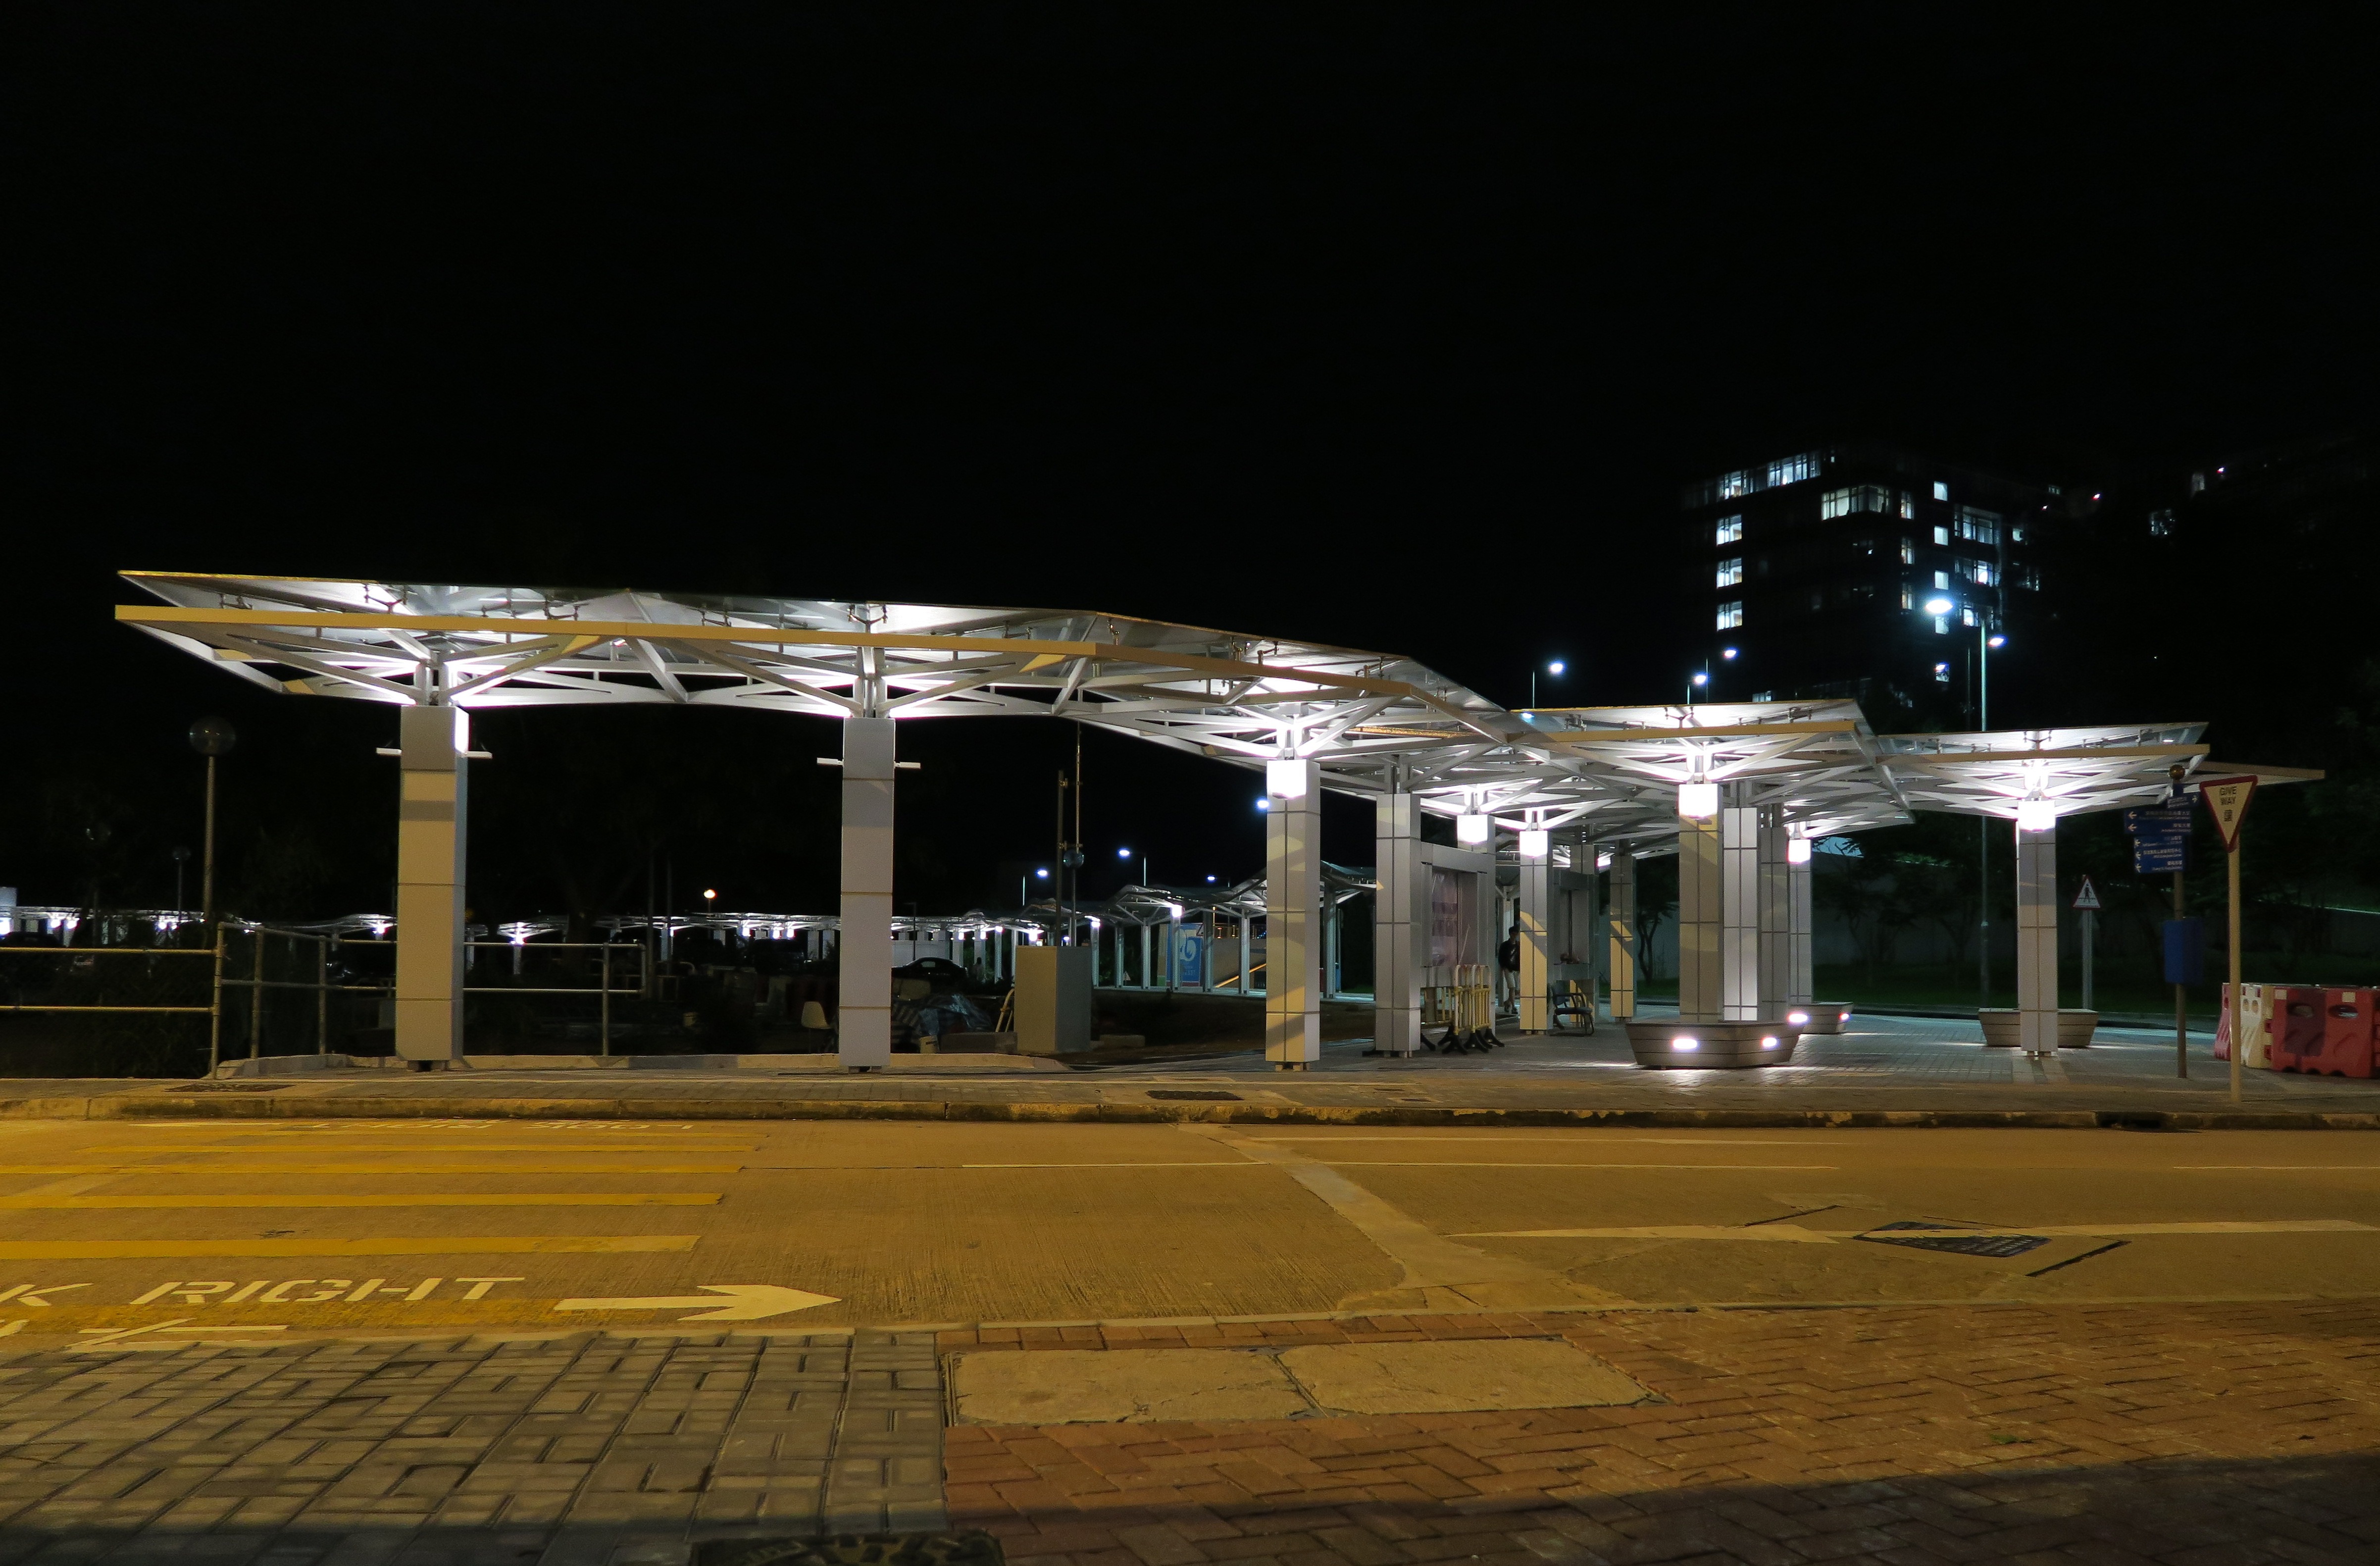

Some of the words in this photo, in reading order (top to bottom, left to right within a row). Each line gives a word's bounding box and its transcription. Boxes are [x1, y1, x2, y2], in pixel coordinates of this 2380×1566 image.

[2220, 786, 2237, 795] GIVE
[2220, 796, 2236, 805] WAY
[129, 1277, 525, 1305] RIGHT
